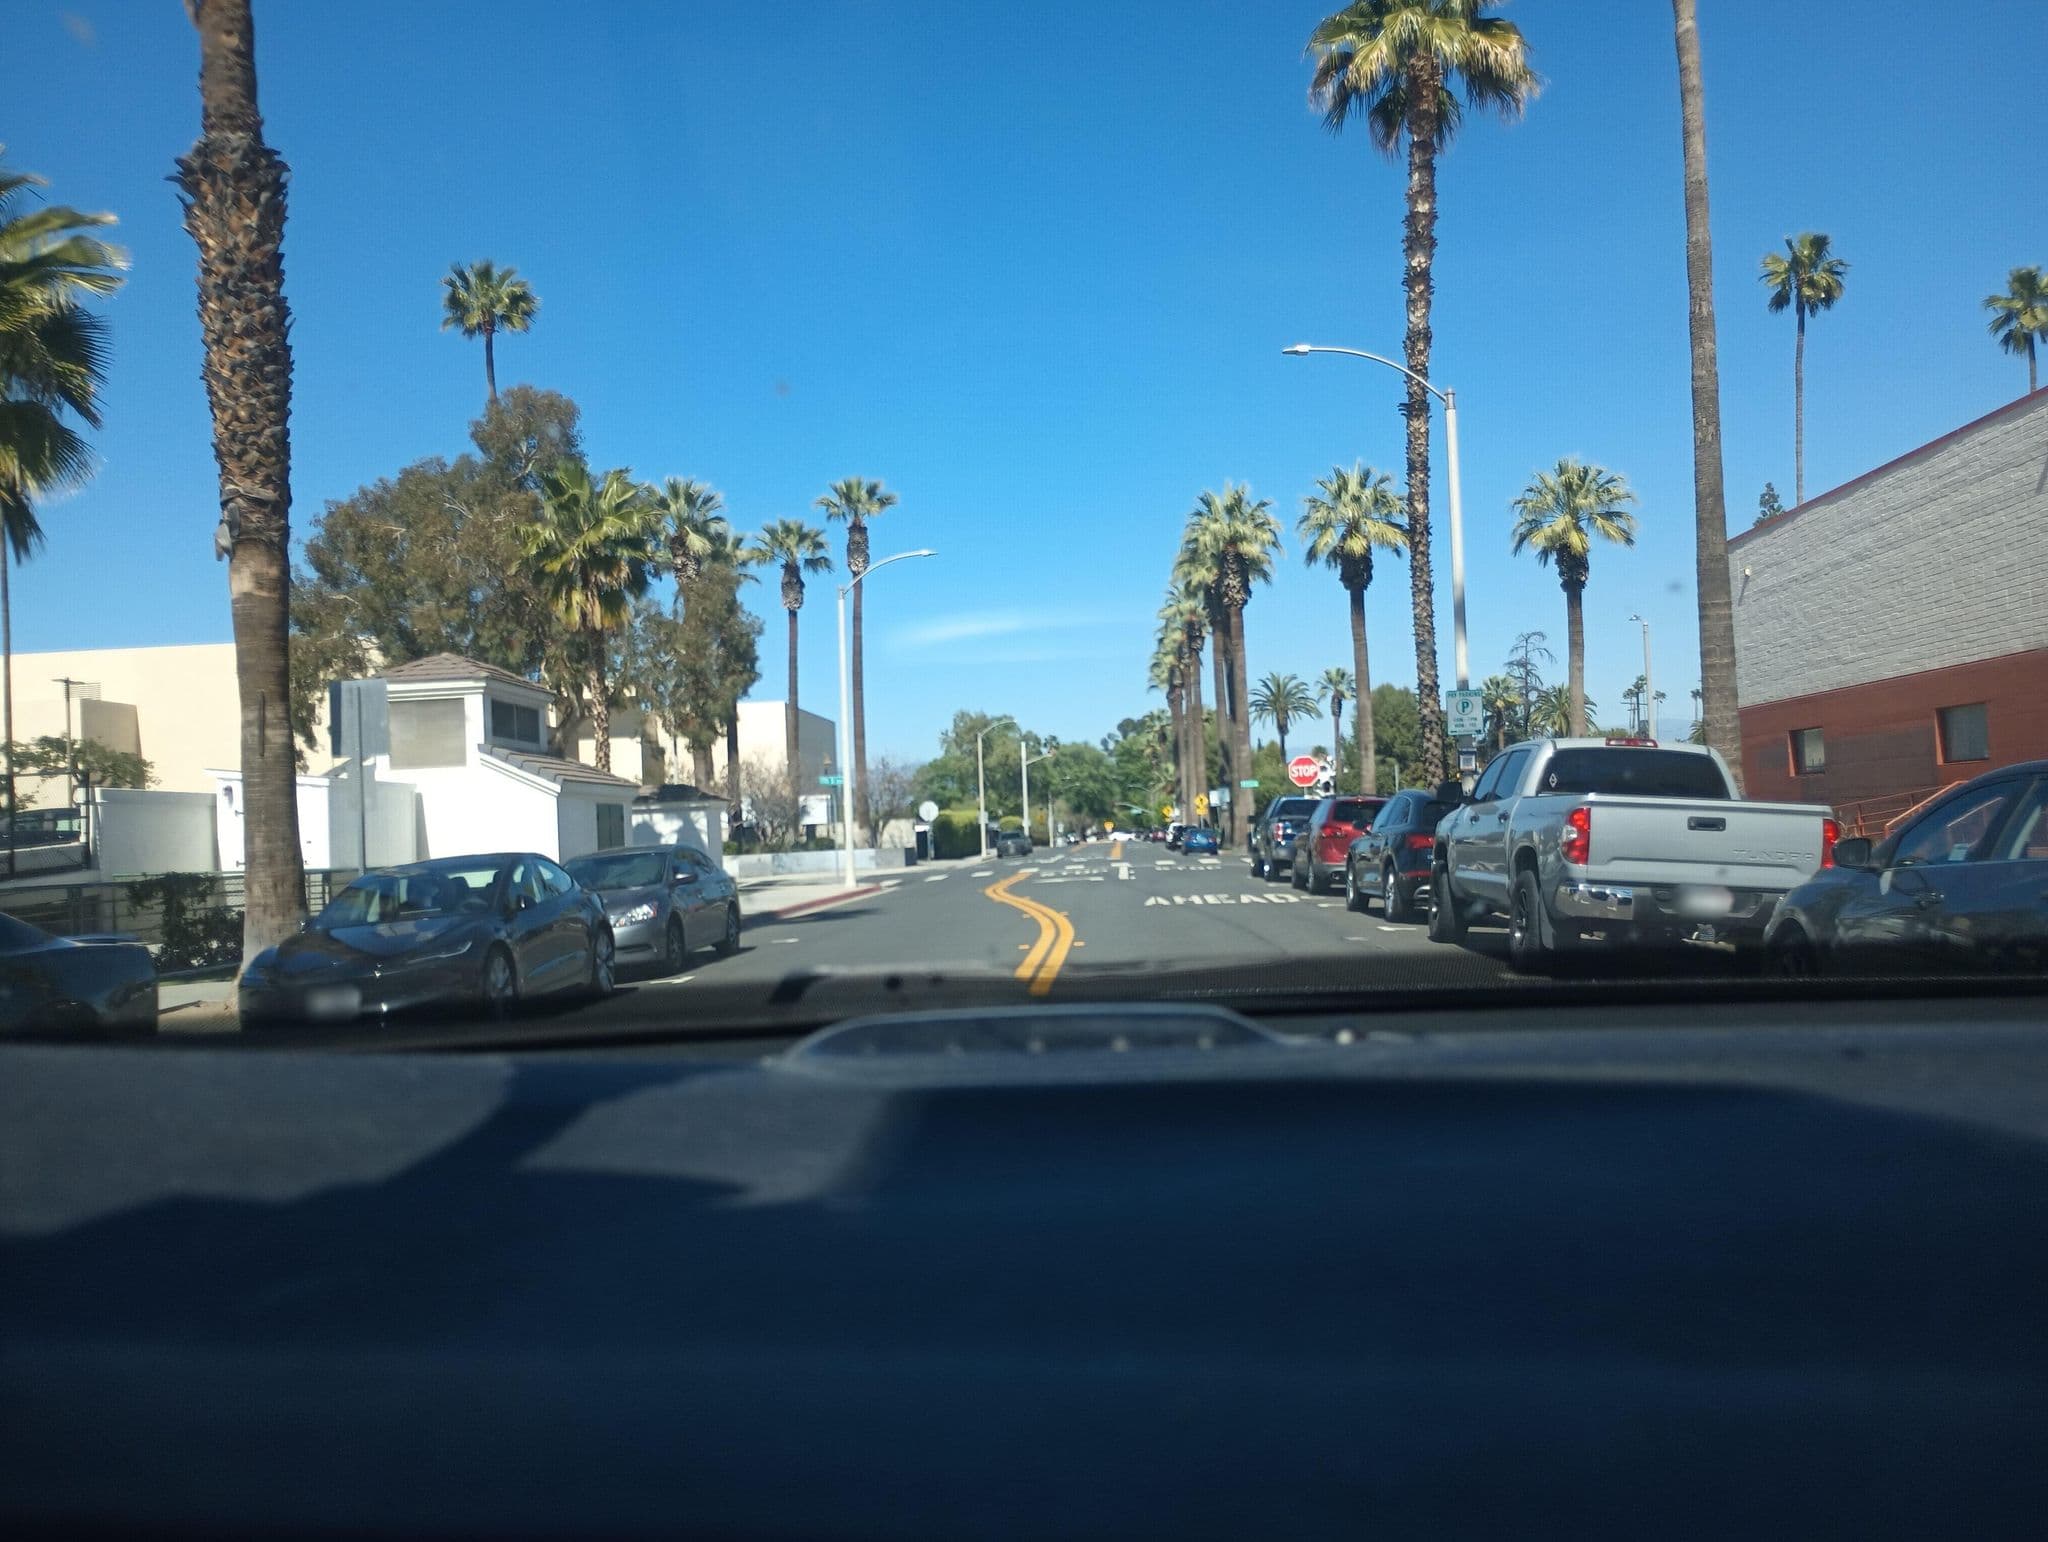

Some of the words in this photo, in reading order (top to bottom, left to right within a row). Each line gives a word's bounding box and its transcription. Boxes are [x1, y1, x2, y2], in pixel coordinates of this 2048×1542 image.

[1291, 765, 1317, 778] STOP
[1732, 848, 1816, 864] TUNDRA
[1144, 893, 1300, 906] AHEAD
